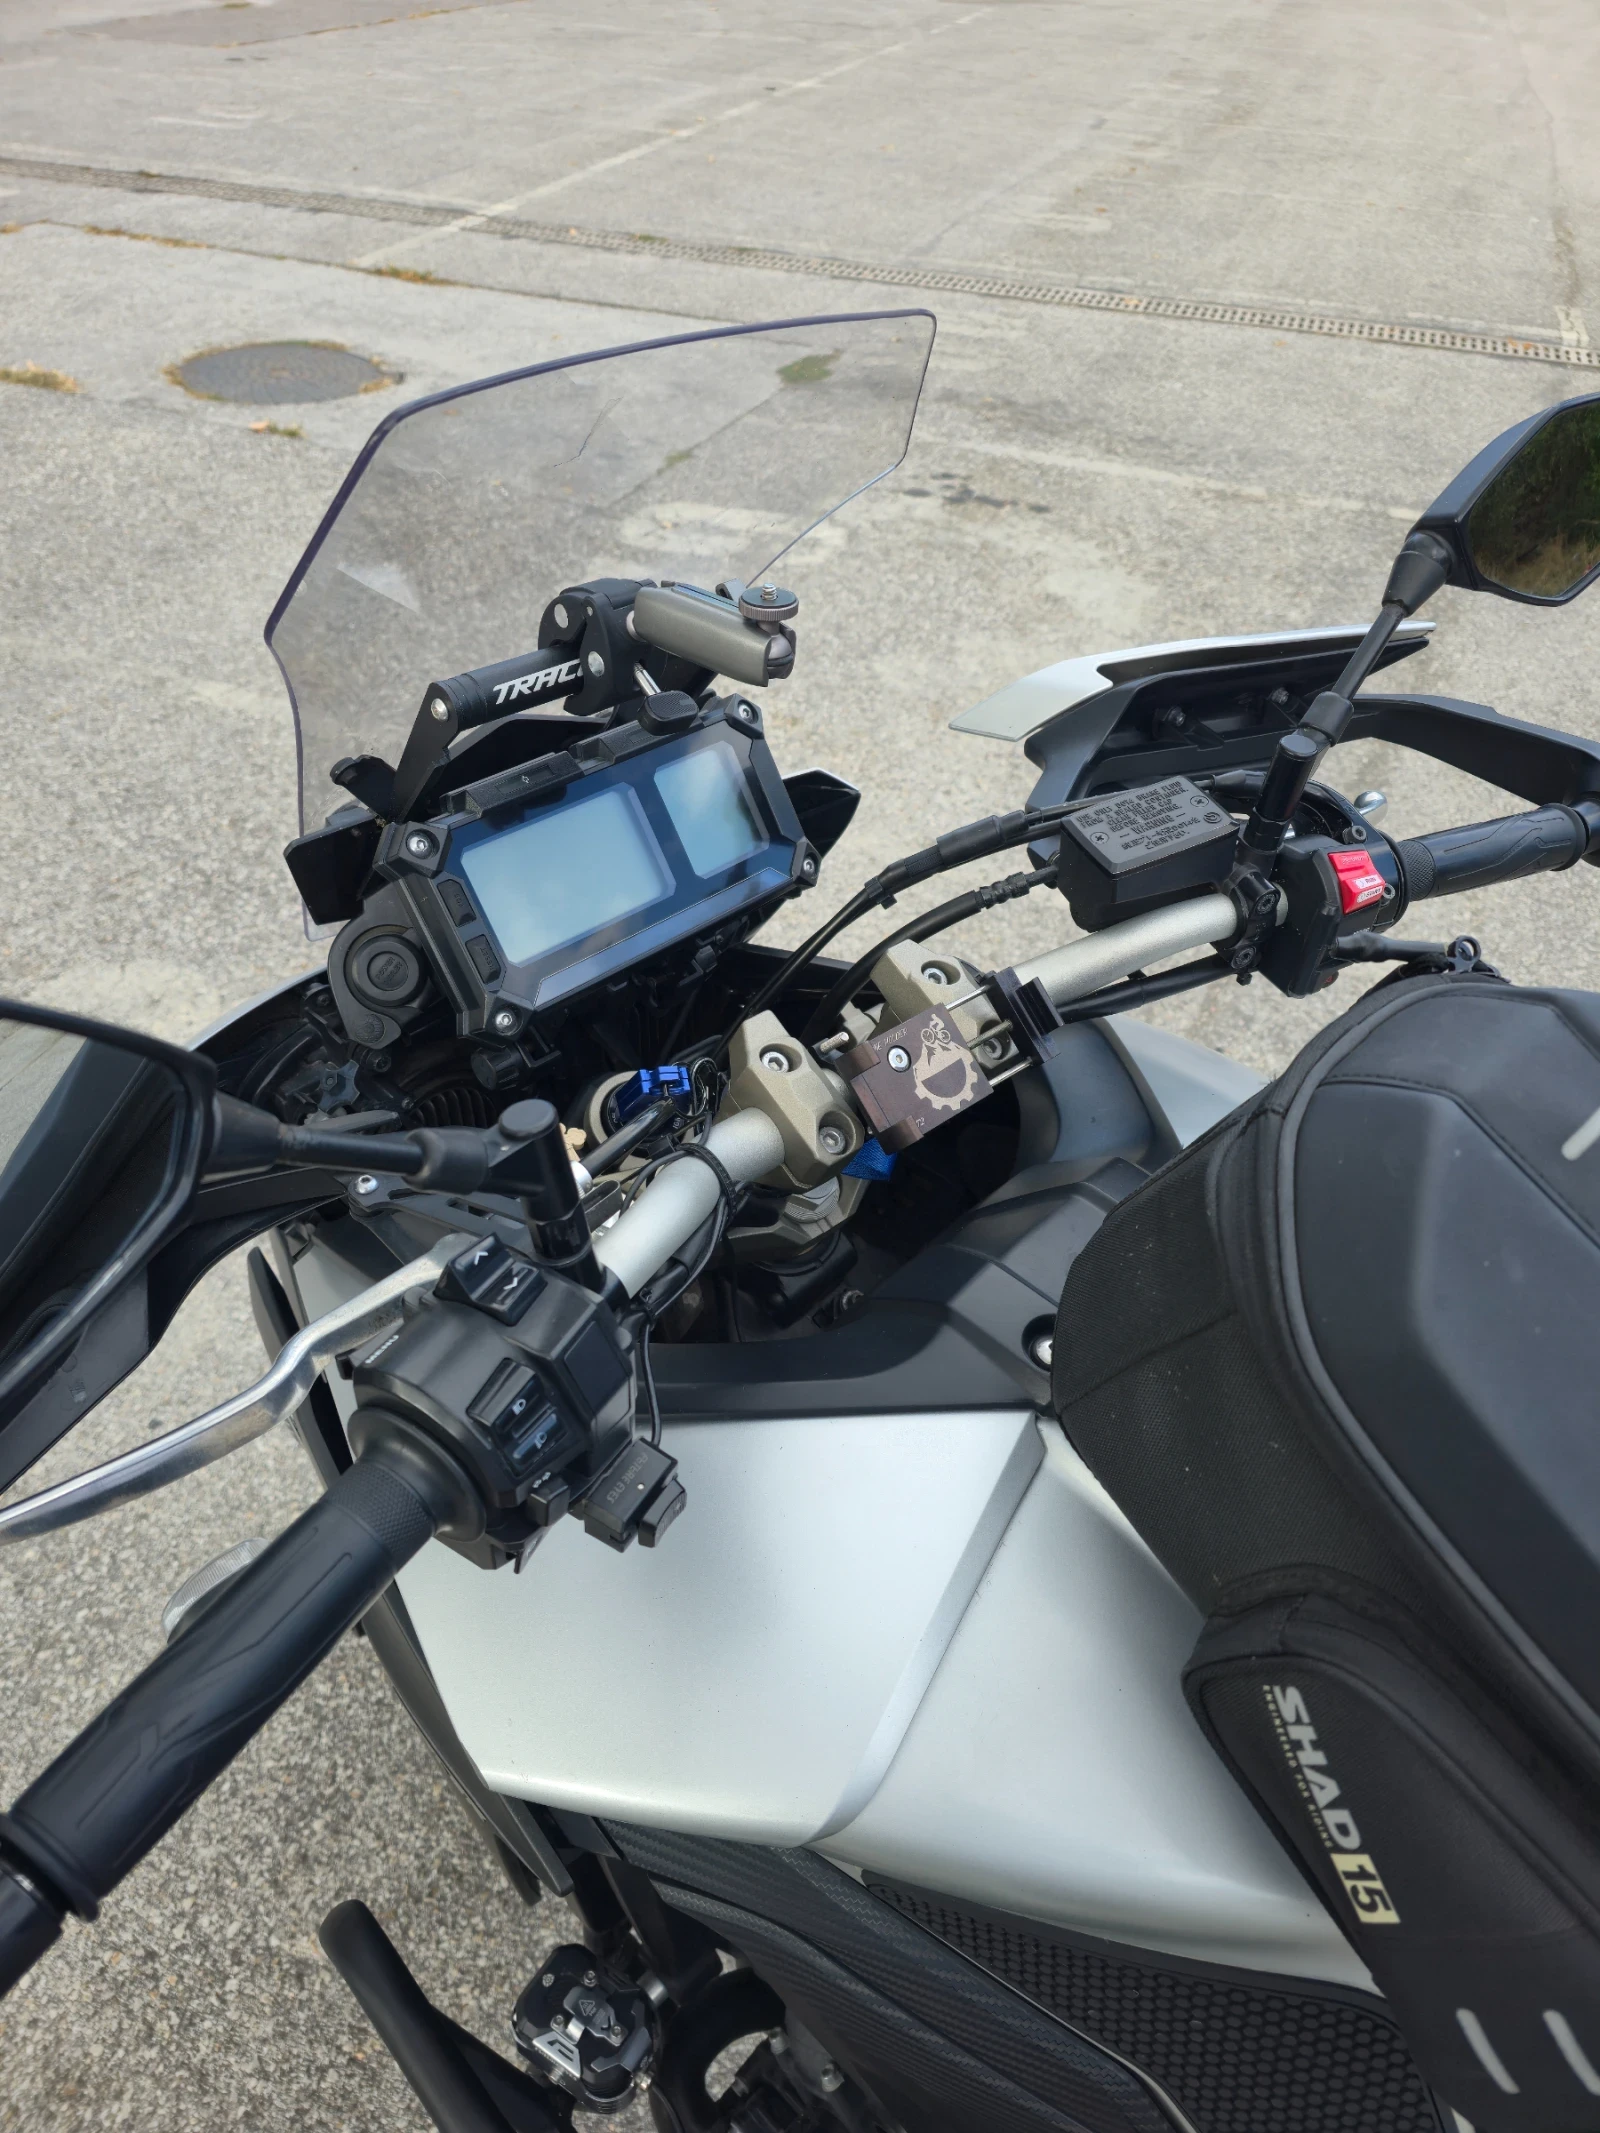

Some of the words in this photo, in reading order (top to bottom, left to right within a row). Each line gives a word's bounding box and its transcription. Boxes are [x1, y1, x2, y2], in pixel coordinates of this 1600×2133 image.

[493, 658, 584, 705] TRAC
[1130, 815, 1175, 834] WARNING
[606, 1481, 626, 1504] EYES
[1262, 1684, 1298, 1769] ENGINEERED
[1294, 1773, 1310, 1798] FOR
[1307, 1804, 1334, 1849] RIDING
[1272, 1685, 1362, 1850] SHAD
[1341, 1863, 1393, 1914] 15
